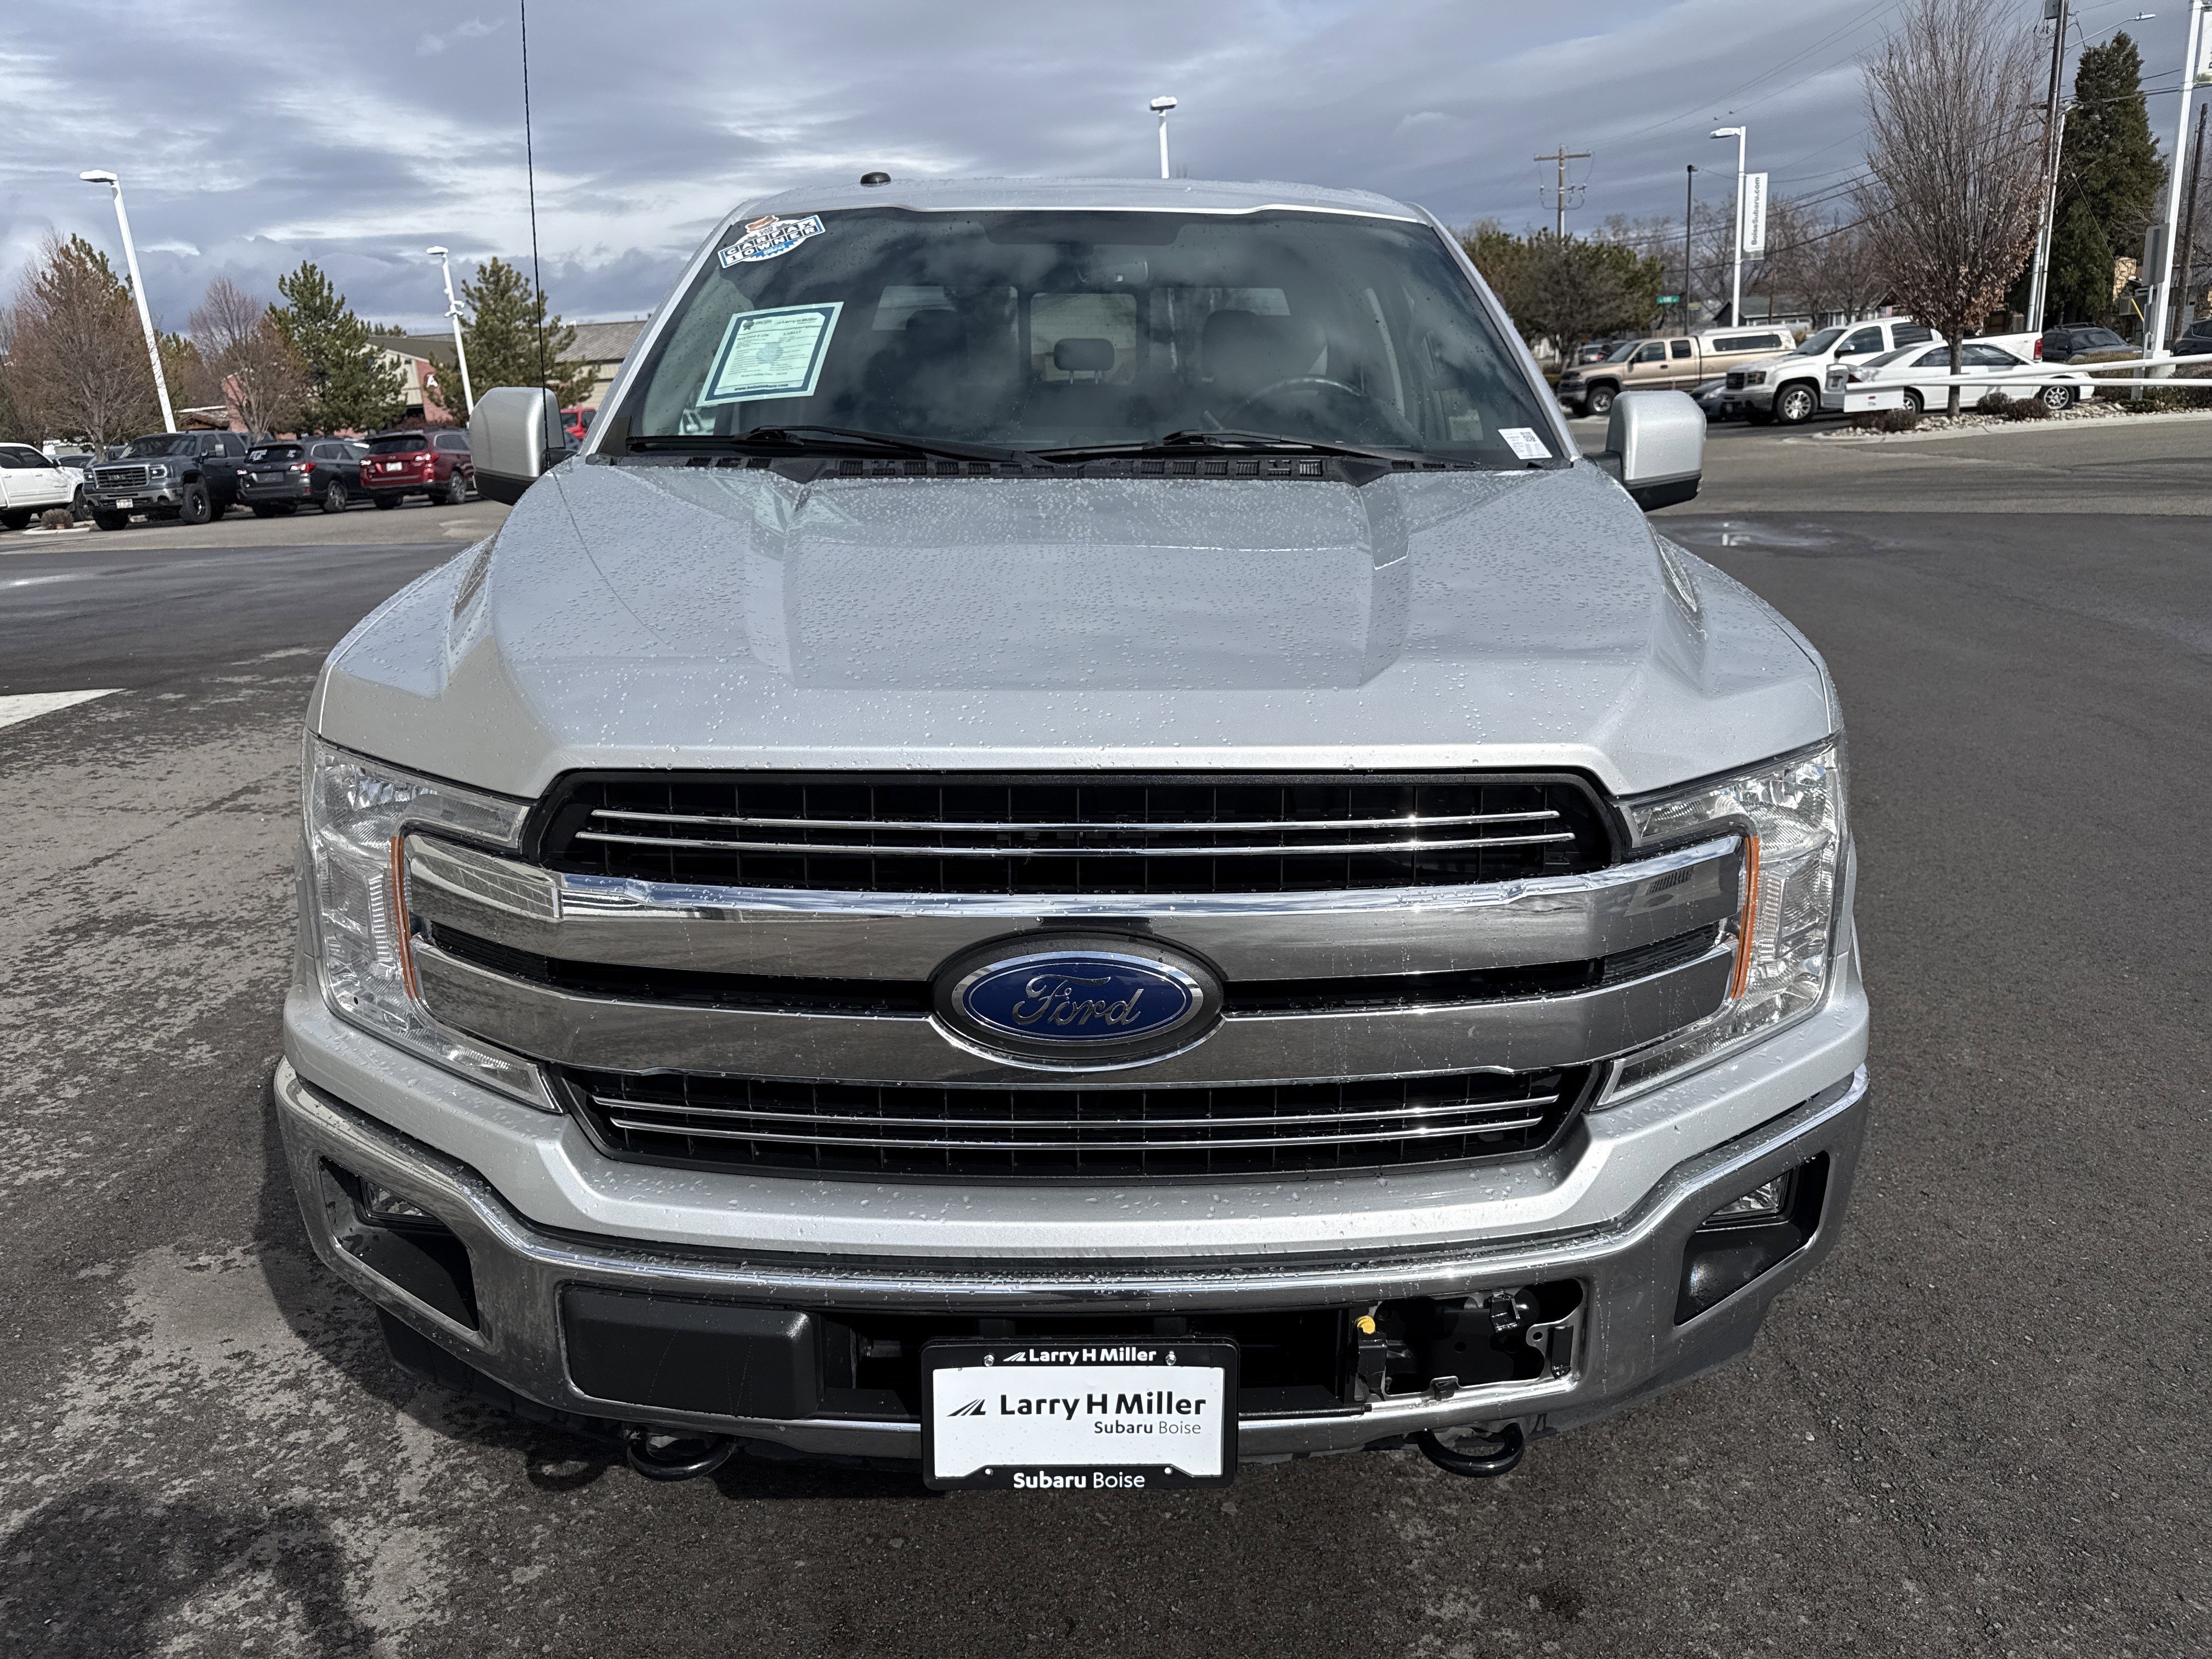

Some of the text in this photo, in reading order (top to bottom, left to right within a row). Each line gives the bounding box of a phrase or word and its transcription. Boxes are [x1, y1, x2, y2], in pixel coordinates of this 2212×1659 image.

[1751, 177, 1760, 245] BoiseSubaru.com
[727, 222, 812, 255] CARFAX
[743, 227, 816, 256] OWNER
[1012, 974, 1144, 1025] Ford
[1029, 1347, 1156, 1364] Larry H Miller
[1000, 1391, 1206, 1420] Larry H Miller
[1093, 1419, 1201, 1435] Subaru Boise
[1013, 1471, 1146, 1489] Subaru Boise
